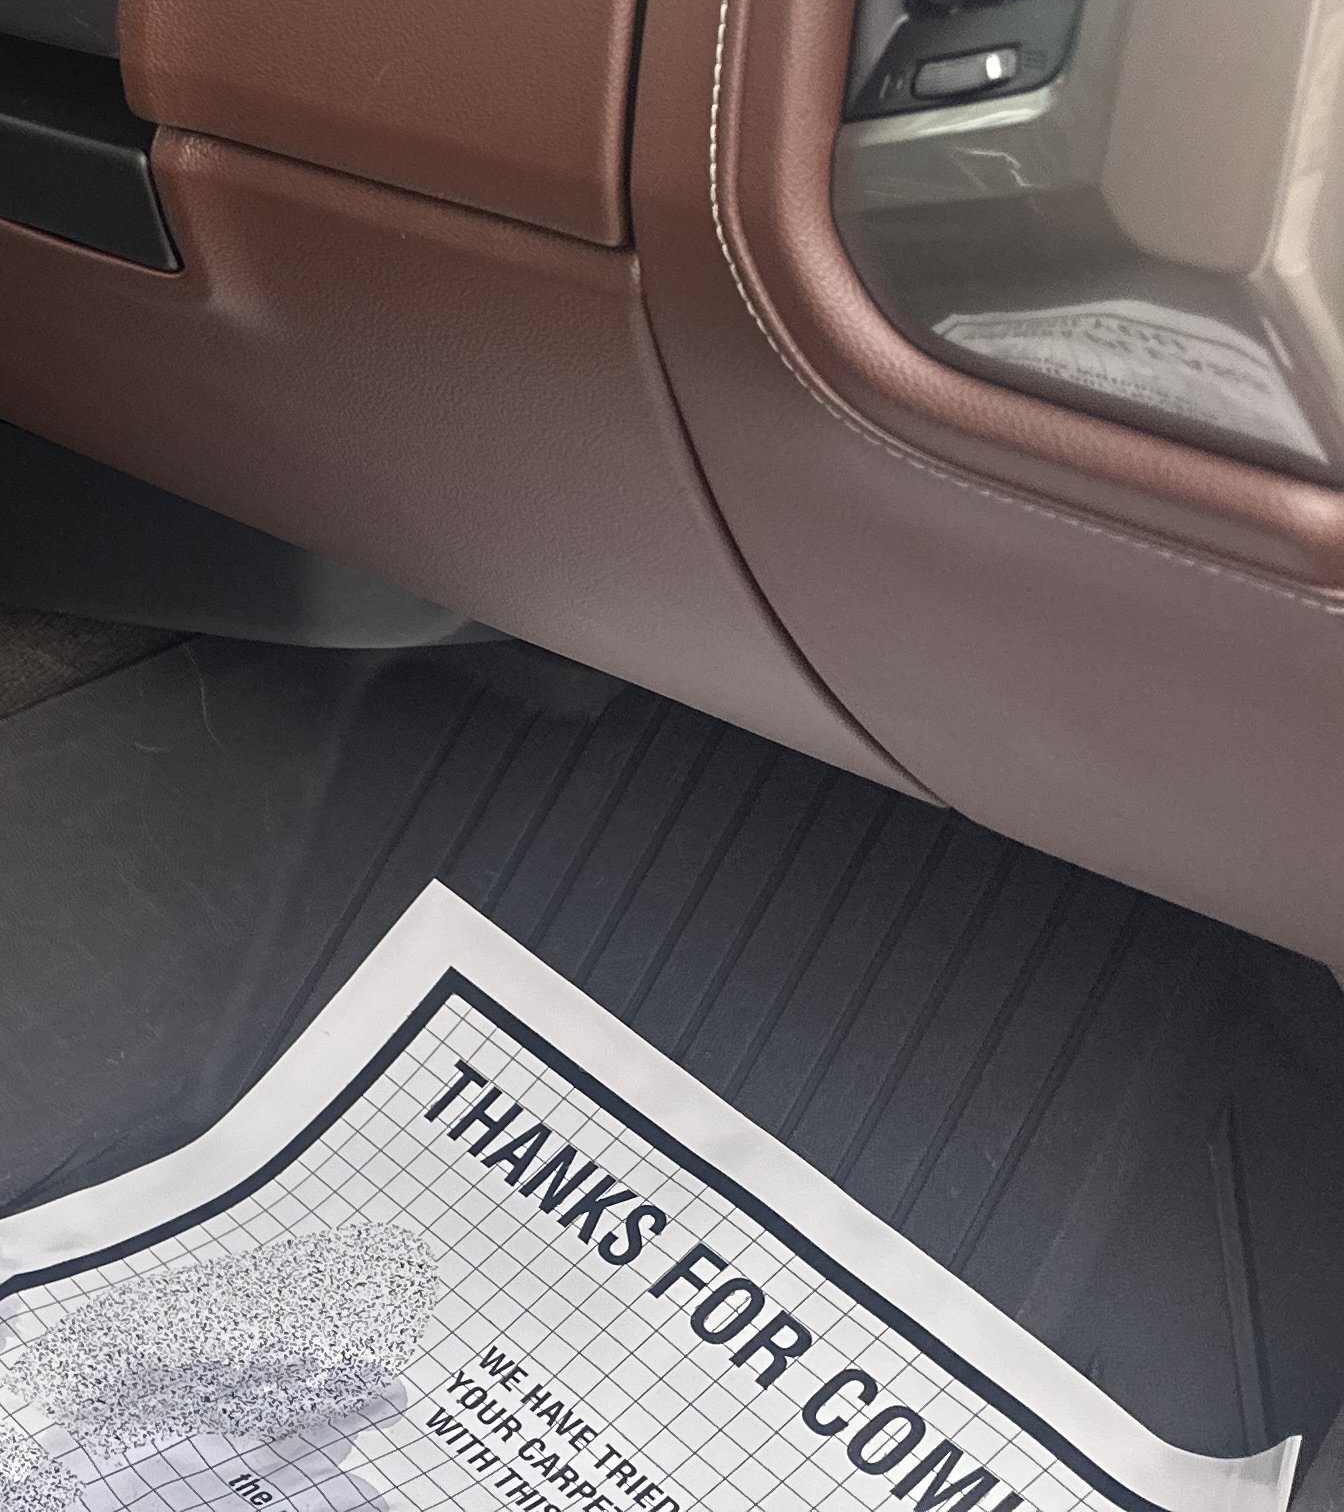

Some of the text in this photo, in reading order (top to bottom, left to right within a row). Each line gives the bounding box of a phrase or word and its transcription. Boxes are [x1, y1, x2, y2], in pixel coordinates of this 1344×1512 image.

[423, 1059, 1025, 1512] THANKS FOR COM
[228, 1472, 274, 1507] the
[425, 1406, 500, 1473] WITH
[446, 1370, 621, 1512] YOUR CARPE
[478, 1345, 680, 1512] WE HAVE TRIED
